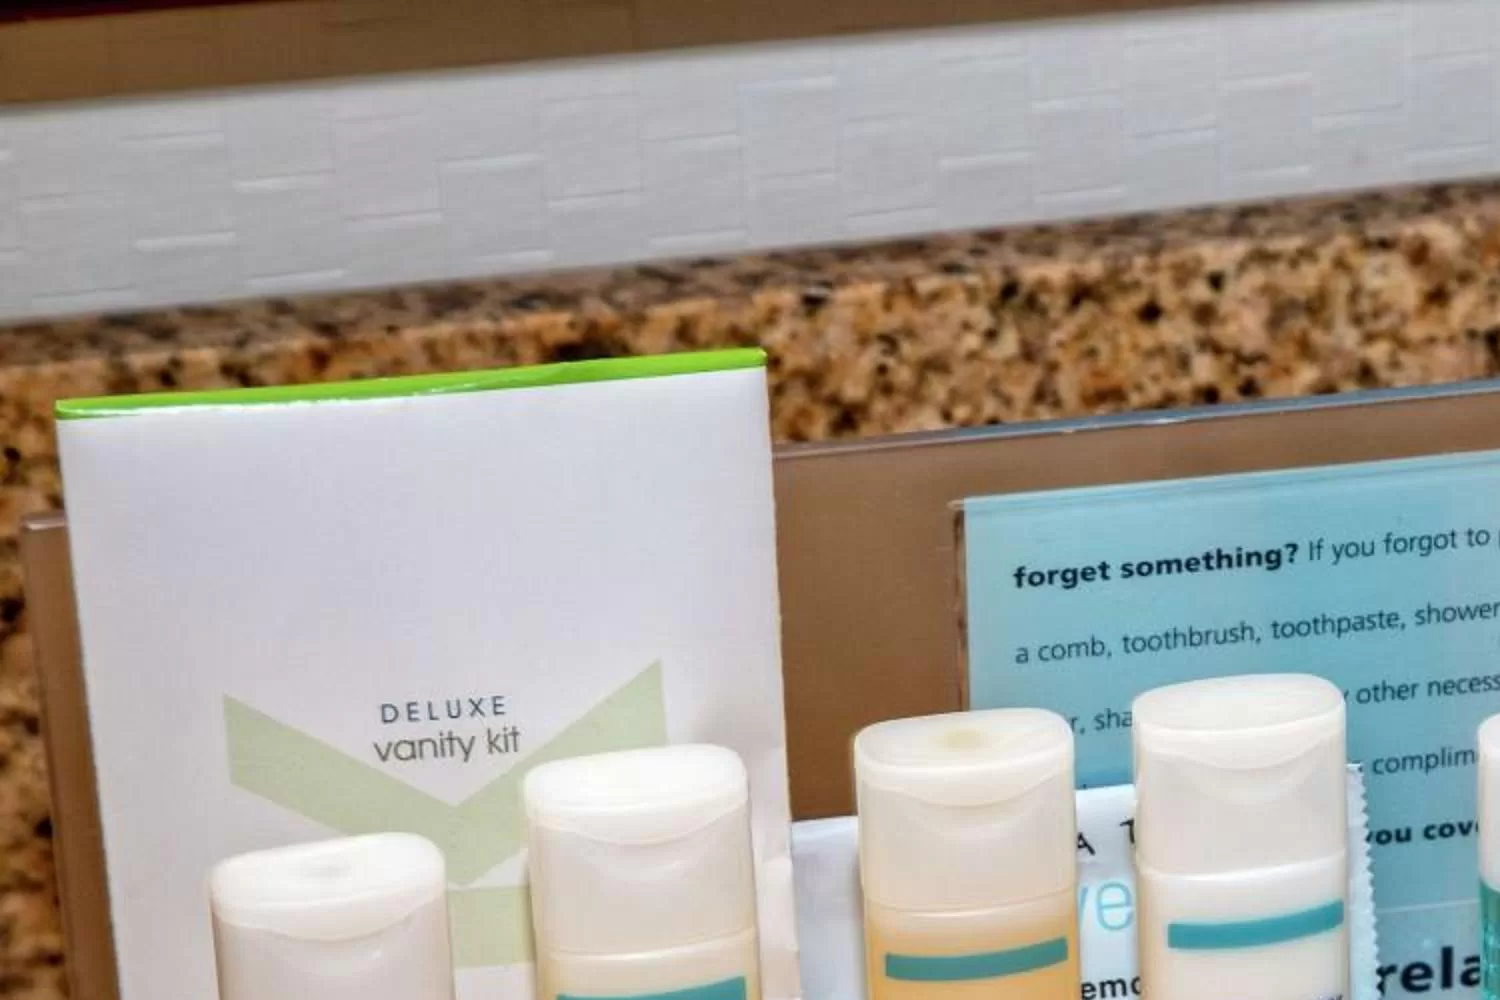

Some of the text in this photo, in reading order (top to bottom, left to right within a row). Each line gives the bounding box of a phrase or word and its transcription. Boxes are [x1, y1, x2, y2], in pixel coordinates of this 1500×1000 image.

[1013, 561, 1111, 589] forget
[1120, 543, 1299, 579] something?
[1308, 538, 1325, 561] If
[1331, 540, 1375, 565] you
[1383, 529, 1457, 556] forgot
[1466, 528, 1490, 547] to
[1015, 647, 1029, 664] a
[1037, 636, 1112, 662] comb,
[1122, 621, 1261, 654] toothbrush,
[1271, 611, 1405, 645] toothpaste,
[1355, 681, 1419, 704] other
[381, 695, 506, 724] DELUXE
[372, 725, 520, 763] vanity kit
[1423, 820, 1479, 840] cov
